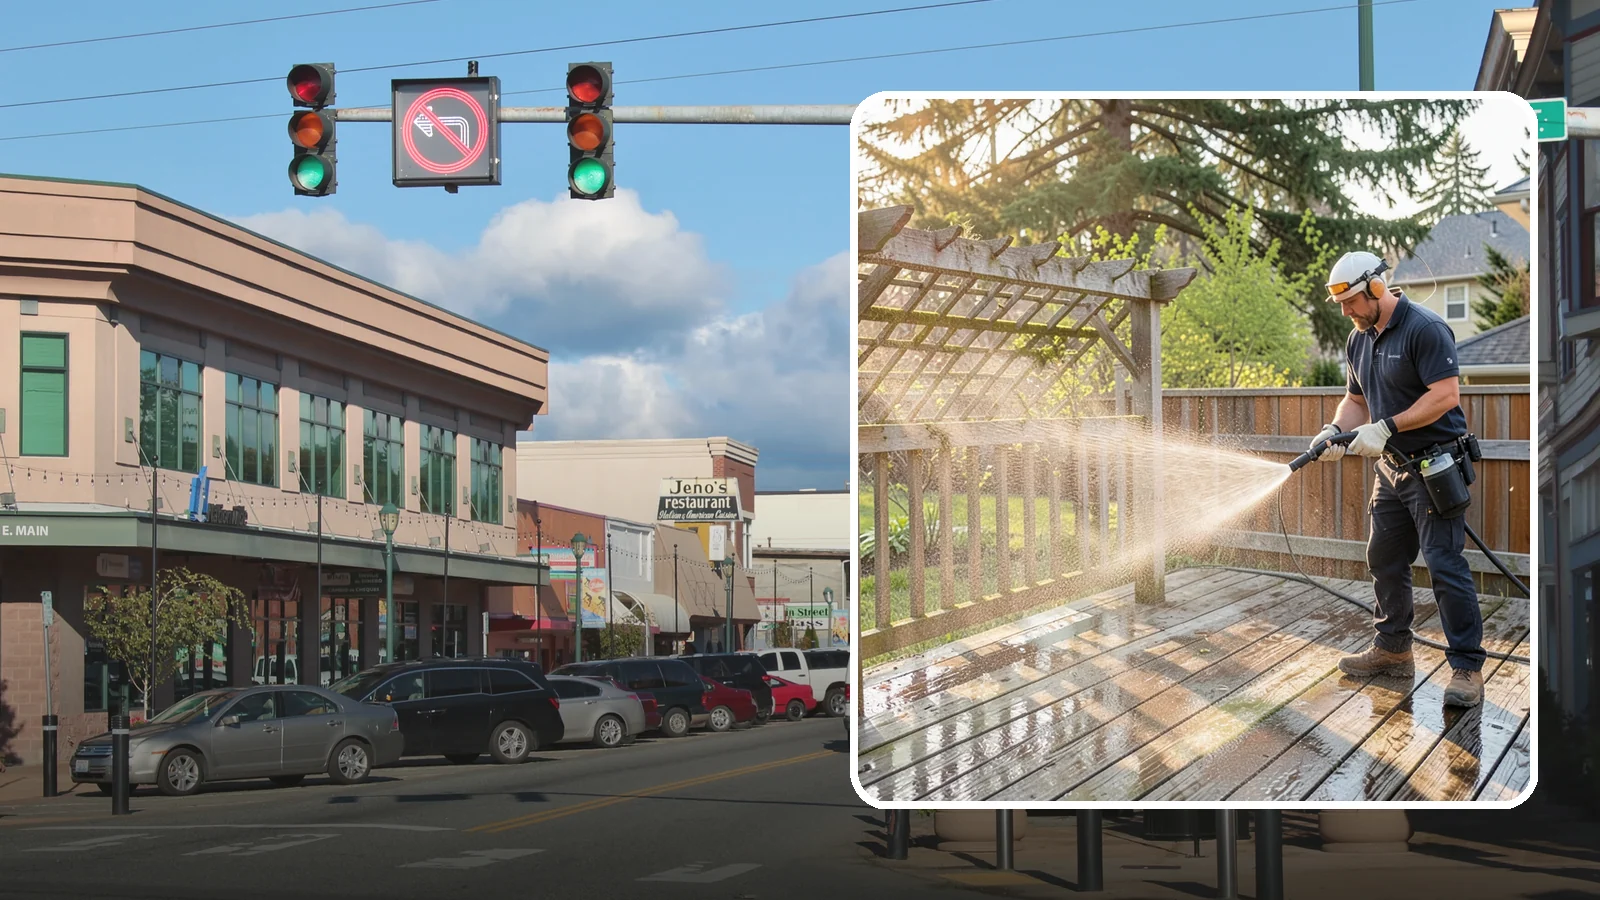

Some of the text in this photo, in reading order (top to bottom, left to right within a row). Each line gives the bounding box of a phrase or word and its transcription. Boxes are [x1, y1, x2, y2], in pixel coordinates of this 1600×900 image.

[669, 480, 728, 494] Jeno's
[665, 496, 731, 509] restaurant
[658, 510, 682, 520] Italian
[685, 510, 715, 519] American
[715, 509, 737, 519] Cuisine
[2, 525, 49, 536] E. MAIN
[797, 608, 828, 616] Street
[791, 619, 823, 627] lass
